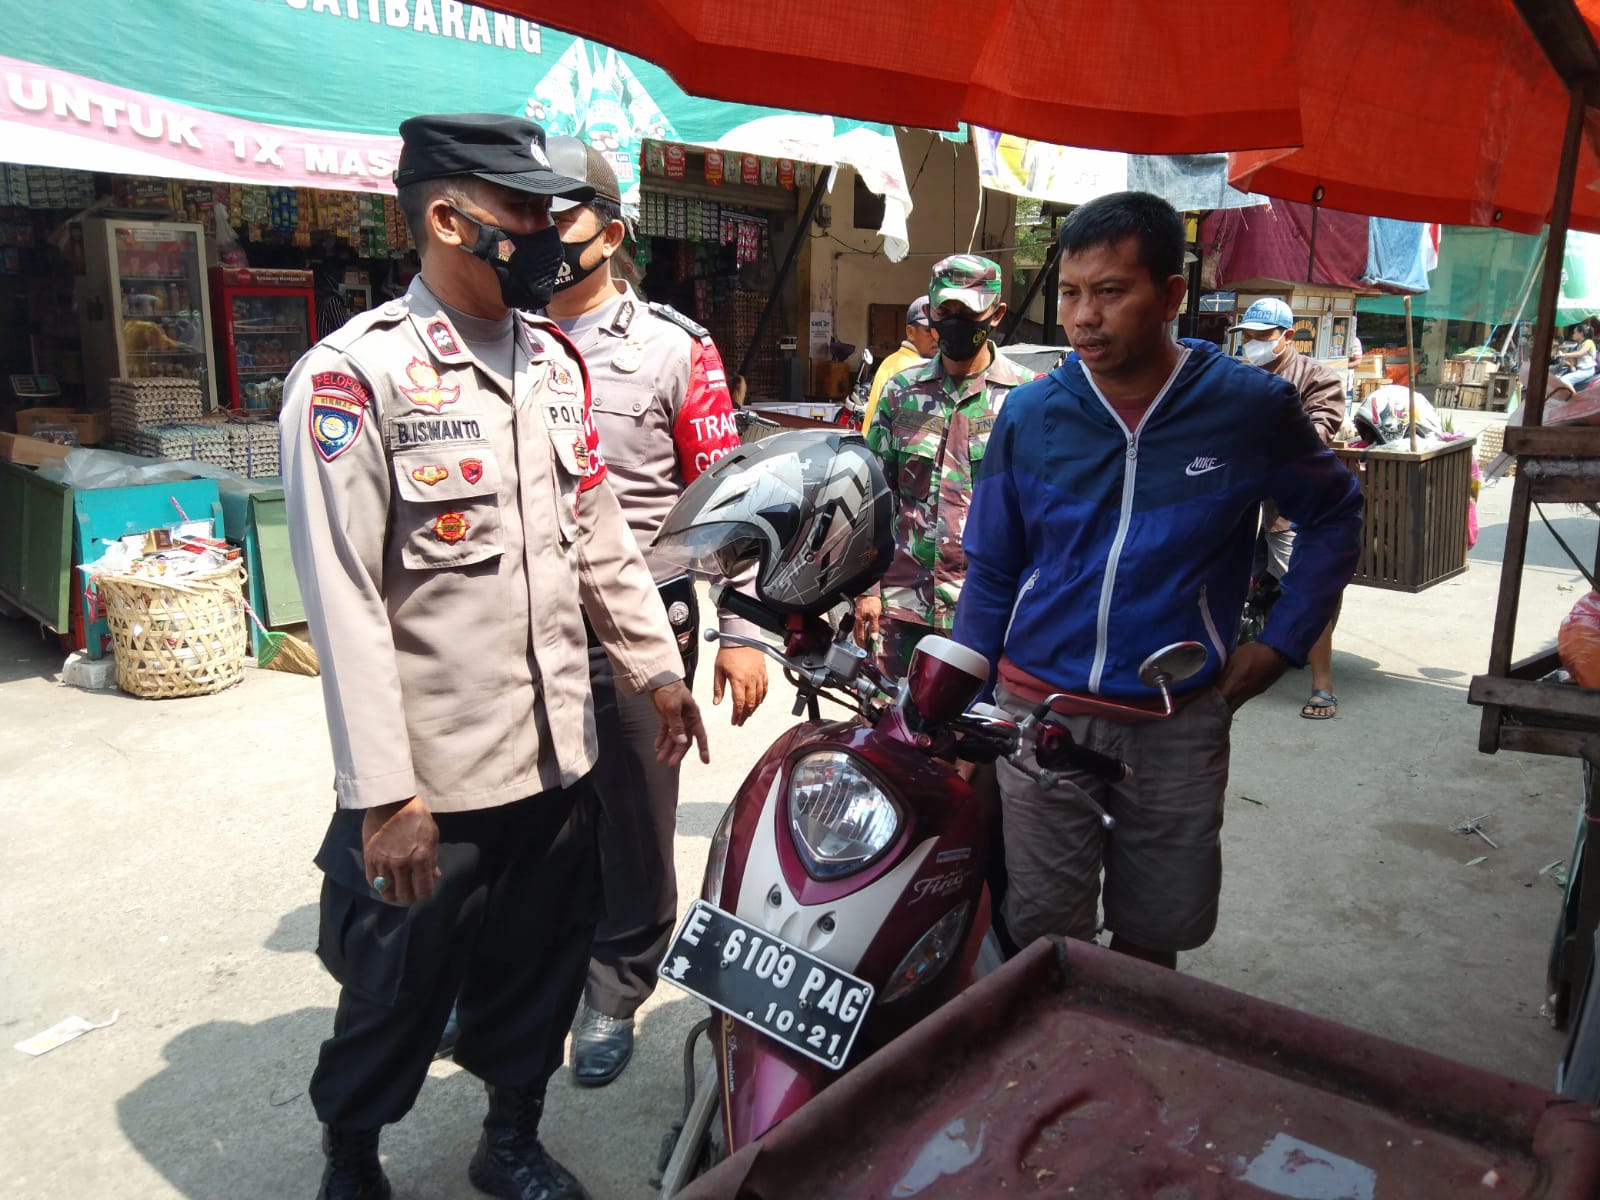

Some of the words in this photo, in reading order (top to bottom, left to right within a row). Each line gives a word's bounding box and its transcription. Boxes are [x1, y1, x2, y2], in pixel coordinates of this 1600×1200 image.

[285, 0, 542, 54] TIBARANG
[5, 72, 203, 149] UNTUK
[226, 129, 285, 167] 1X
[398, 419, 481, 444] B.ISWANTO
[1191, 456, 1217, 469] NIKE
[682, 909, 713, 947] E
[723, 928, 797, 989] 6109
[798, 966, 865, 1023] PAG
